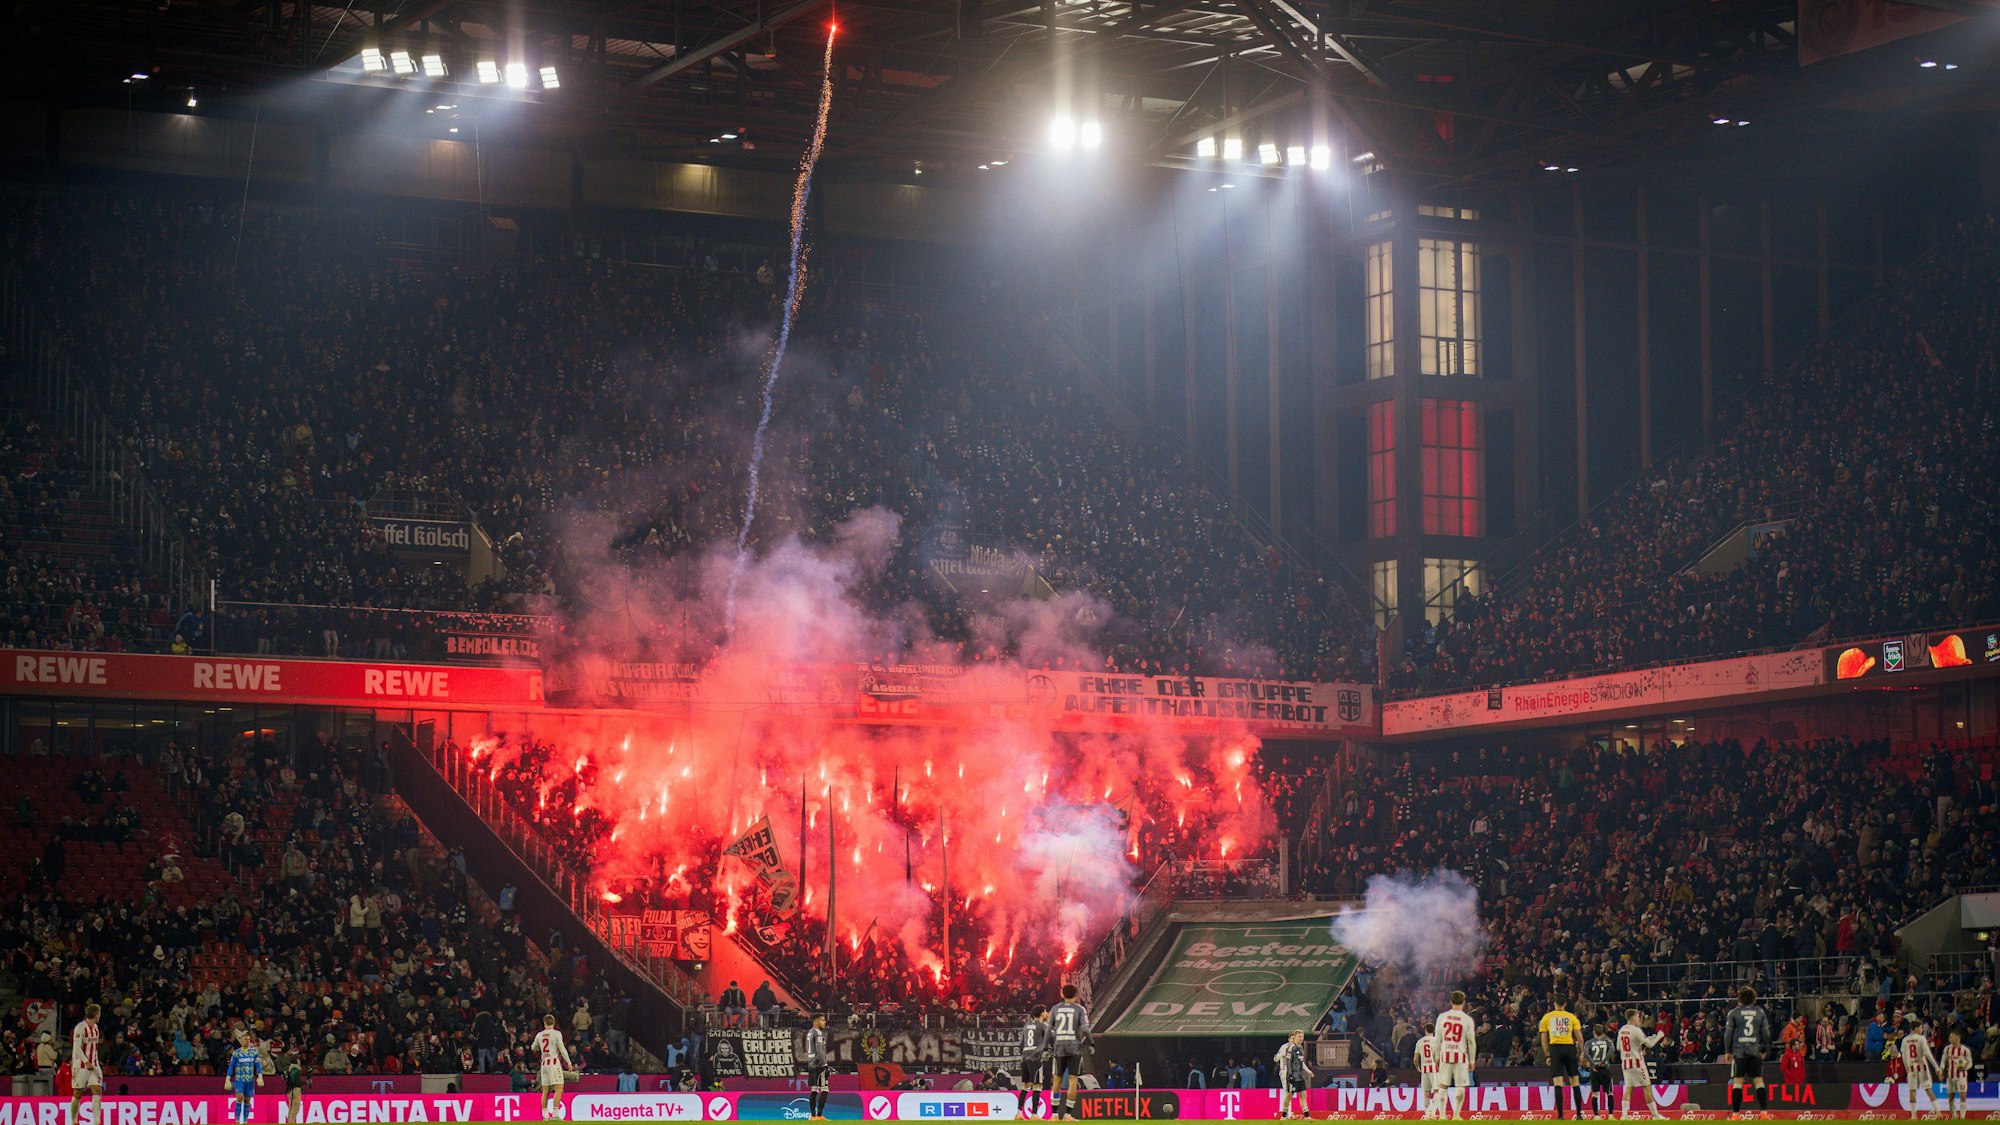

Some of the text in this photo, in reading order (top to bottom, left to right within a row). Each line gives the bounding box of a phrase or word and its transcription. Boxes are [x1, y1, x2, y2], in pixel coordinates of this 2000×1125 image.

[383, 524, 411, 545] ffel
[16, 655, 107, 685] REWE
[193, 662, 282, 691] REWE
[364, 669, 449, 698] REWE
[871, 684, 921, 693] ASOZIAL
[1079, 676, 1144, 695] EHRE
[1157, 679, 1205, 698] DER
[1218, 682, 1312, 703] GRUPPE
[643, 909, 672, 924] FULDA
[1184, 941, 1351, 958] Bestens
[1175, 957, 1345, 972] abgesichert
[1138, 1001, 1317, 1017] DEVK
[1056, 1013, 1075, 1035] 21
[1443, 1021, 1463, 1043] 29
[1743, 1015, 1754, 1037] 3
[742, 1028, 792, 1039] EHRE DER
[1027, 1029, 1035, 1047] 8
[542, 1038, 549, 1053] 2
[743, 1040, 792, 1053] GRUPPE
[972, 1045, 1021, 1056] NEVER
[1423, 1044, 1431, 1058] 6
[1591, 1045, 1608, 1061] 27
[1620, 1036, 1631, 1054] 18
[1909, 1044, 1917, 1058] 8
[745, 1053, 794, 1065] STADION
[746, 1065, 795, 1077] VERBOT
[278, 1099, 474, 1124] MAGENTA TV
[590, 1103, 684, 1121] Magenta TV+
[1081, 1097, 1152, 1119] NETFLIX
